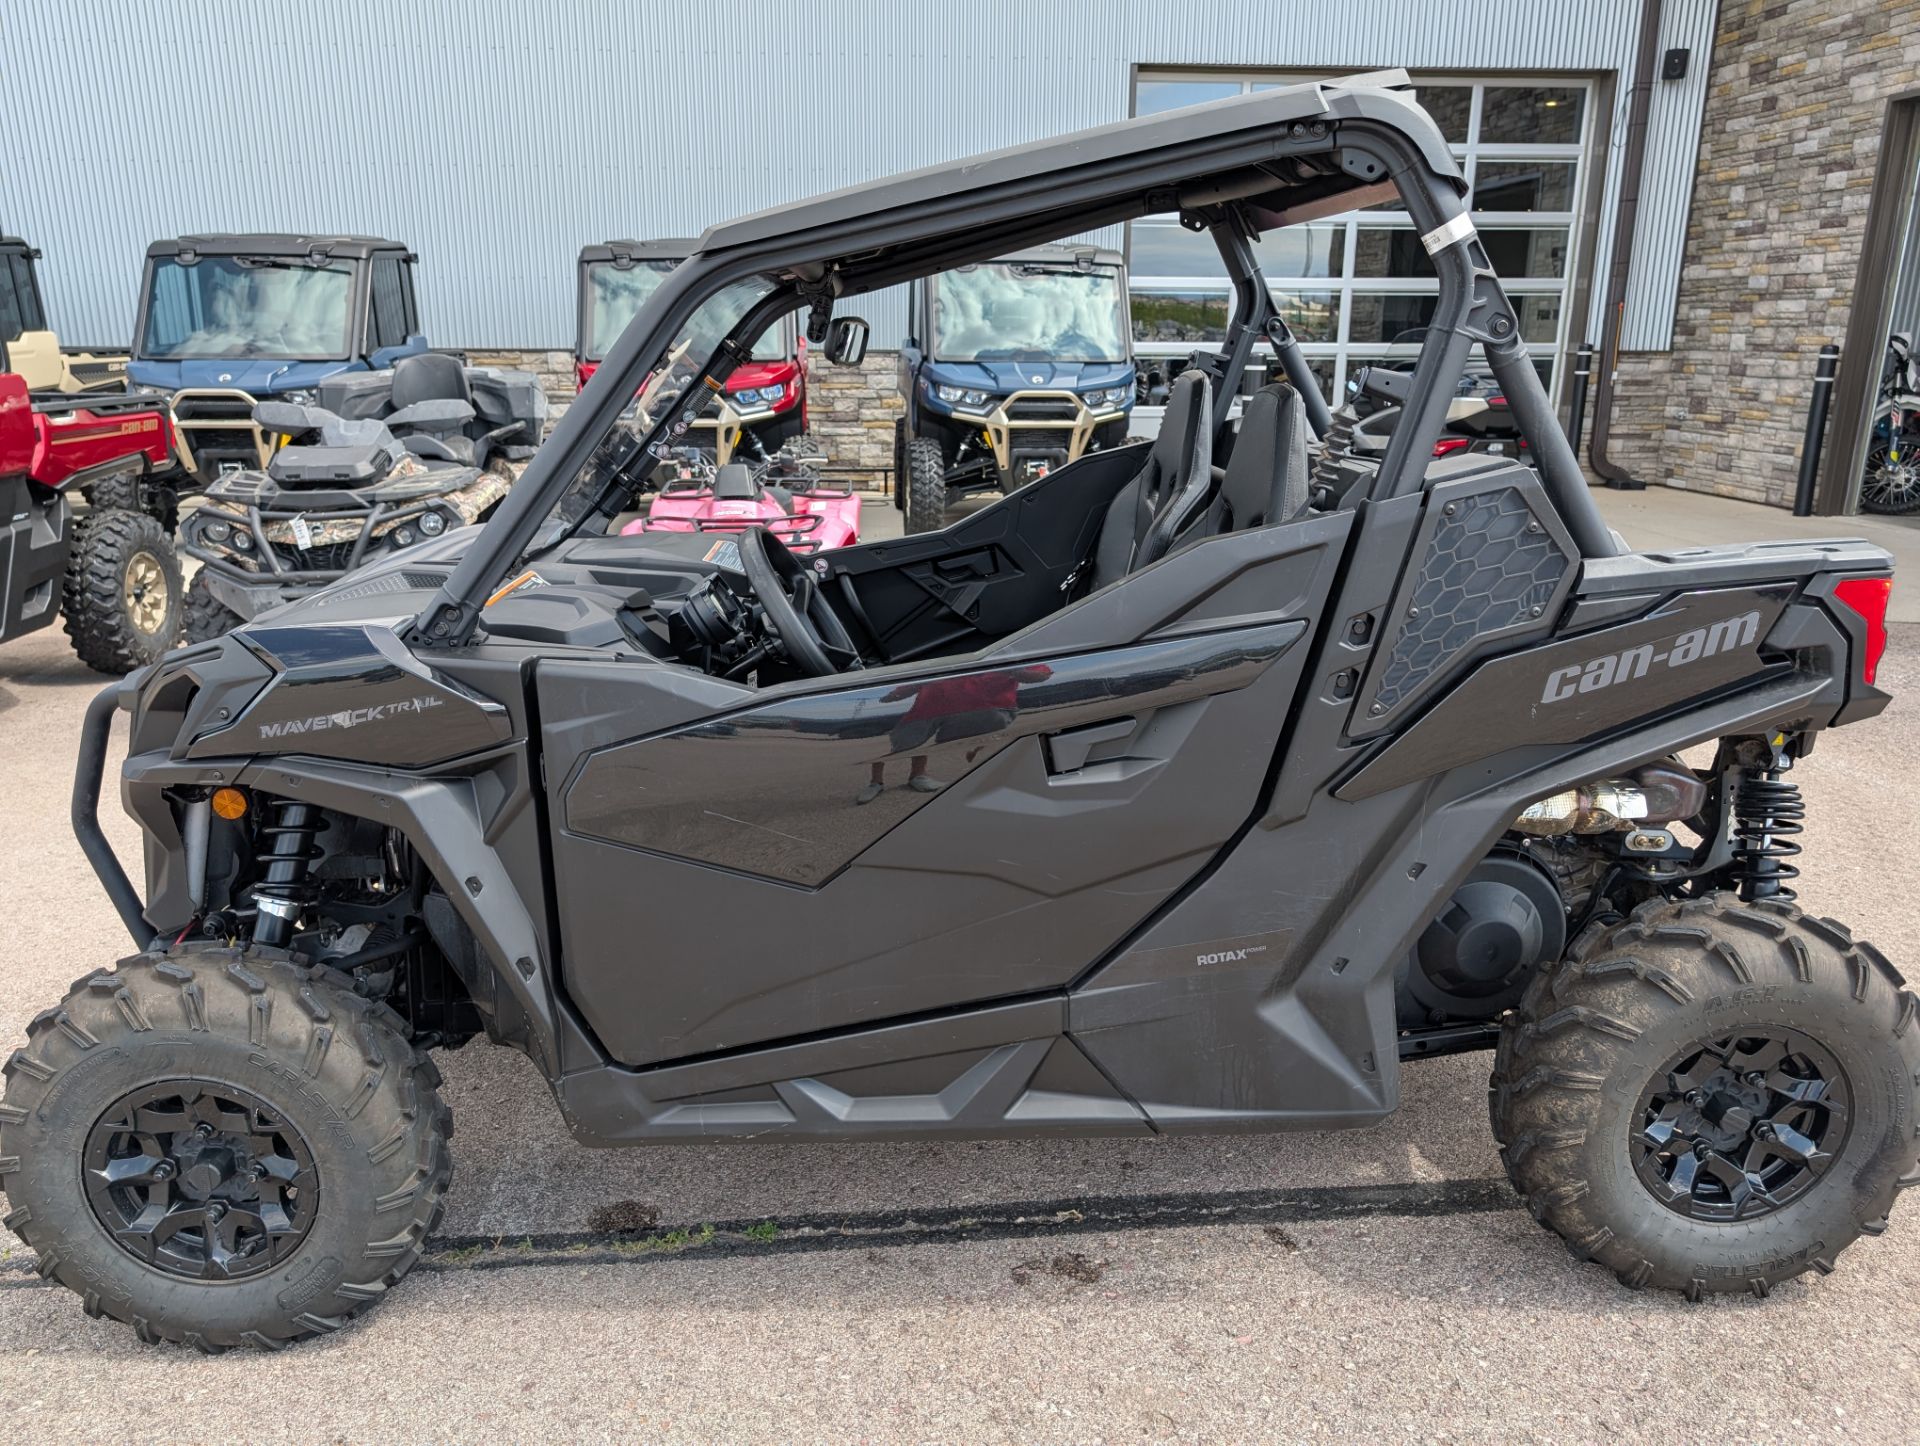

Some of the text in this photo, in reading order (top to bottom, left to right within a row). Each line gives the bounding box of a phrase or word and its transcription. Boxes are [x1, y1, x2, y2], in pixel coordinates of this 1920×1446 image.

[1541, 609, 1761, 703] can-am
[260, 696, 443, 738] MAVERICK TRAIL
[1196, 948, 1247, 966] ROTAX
